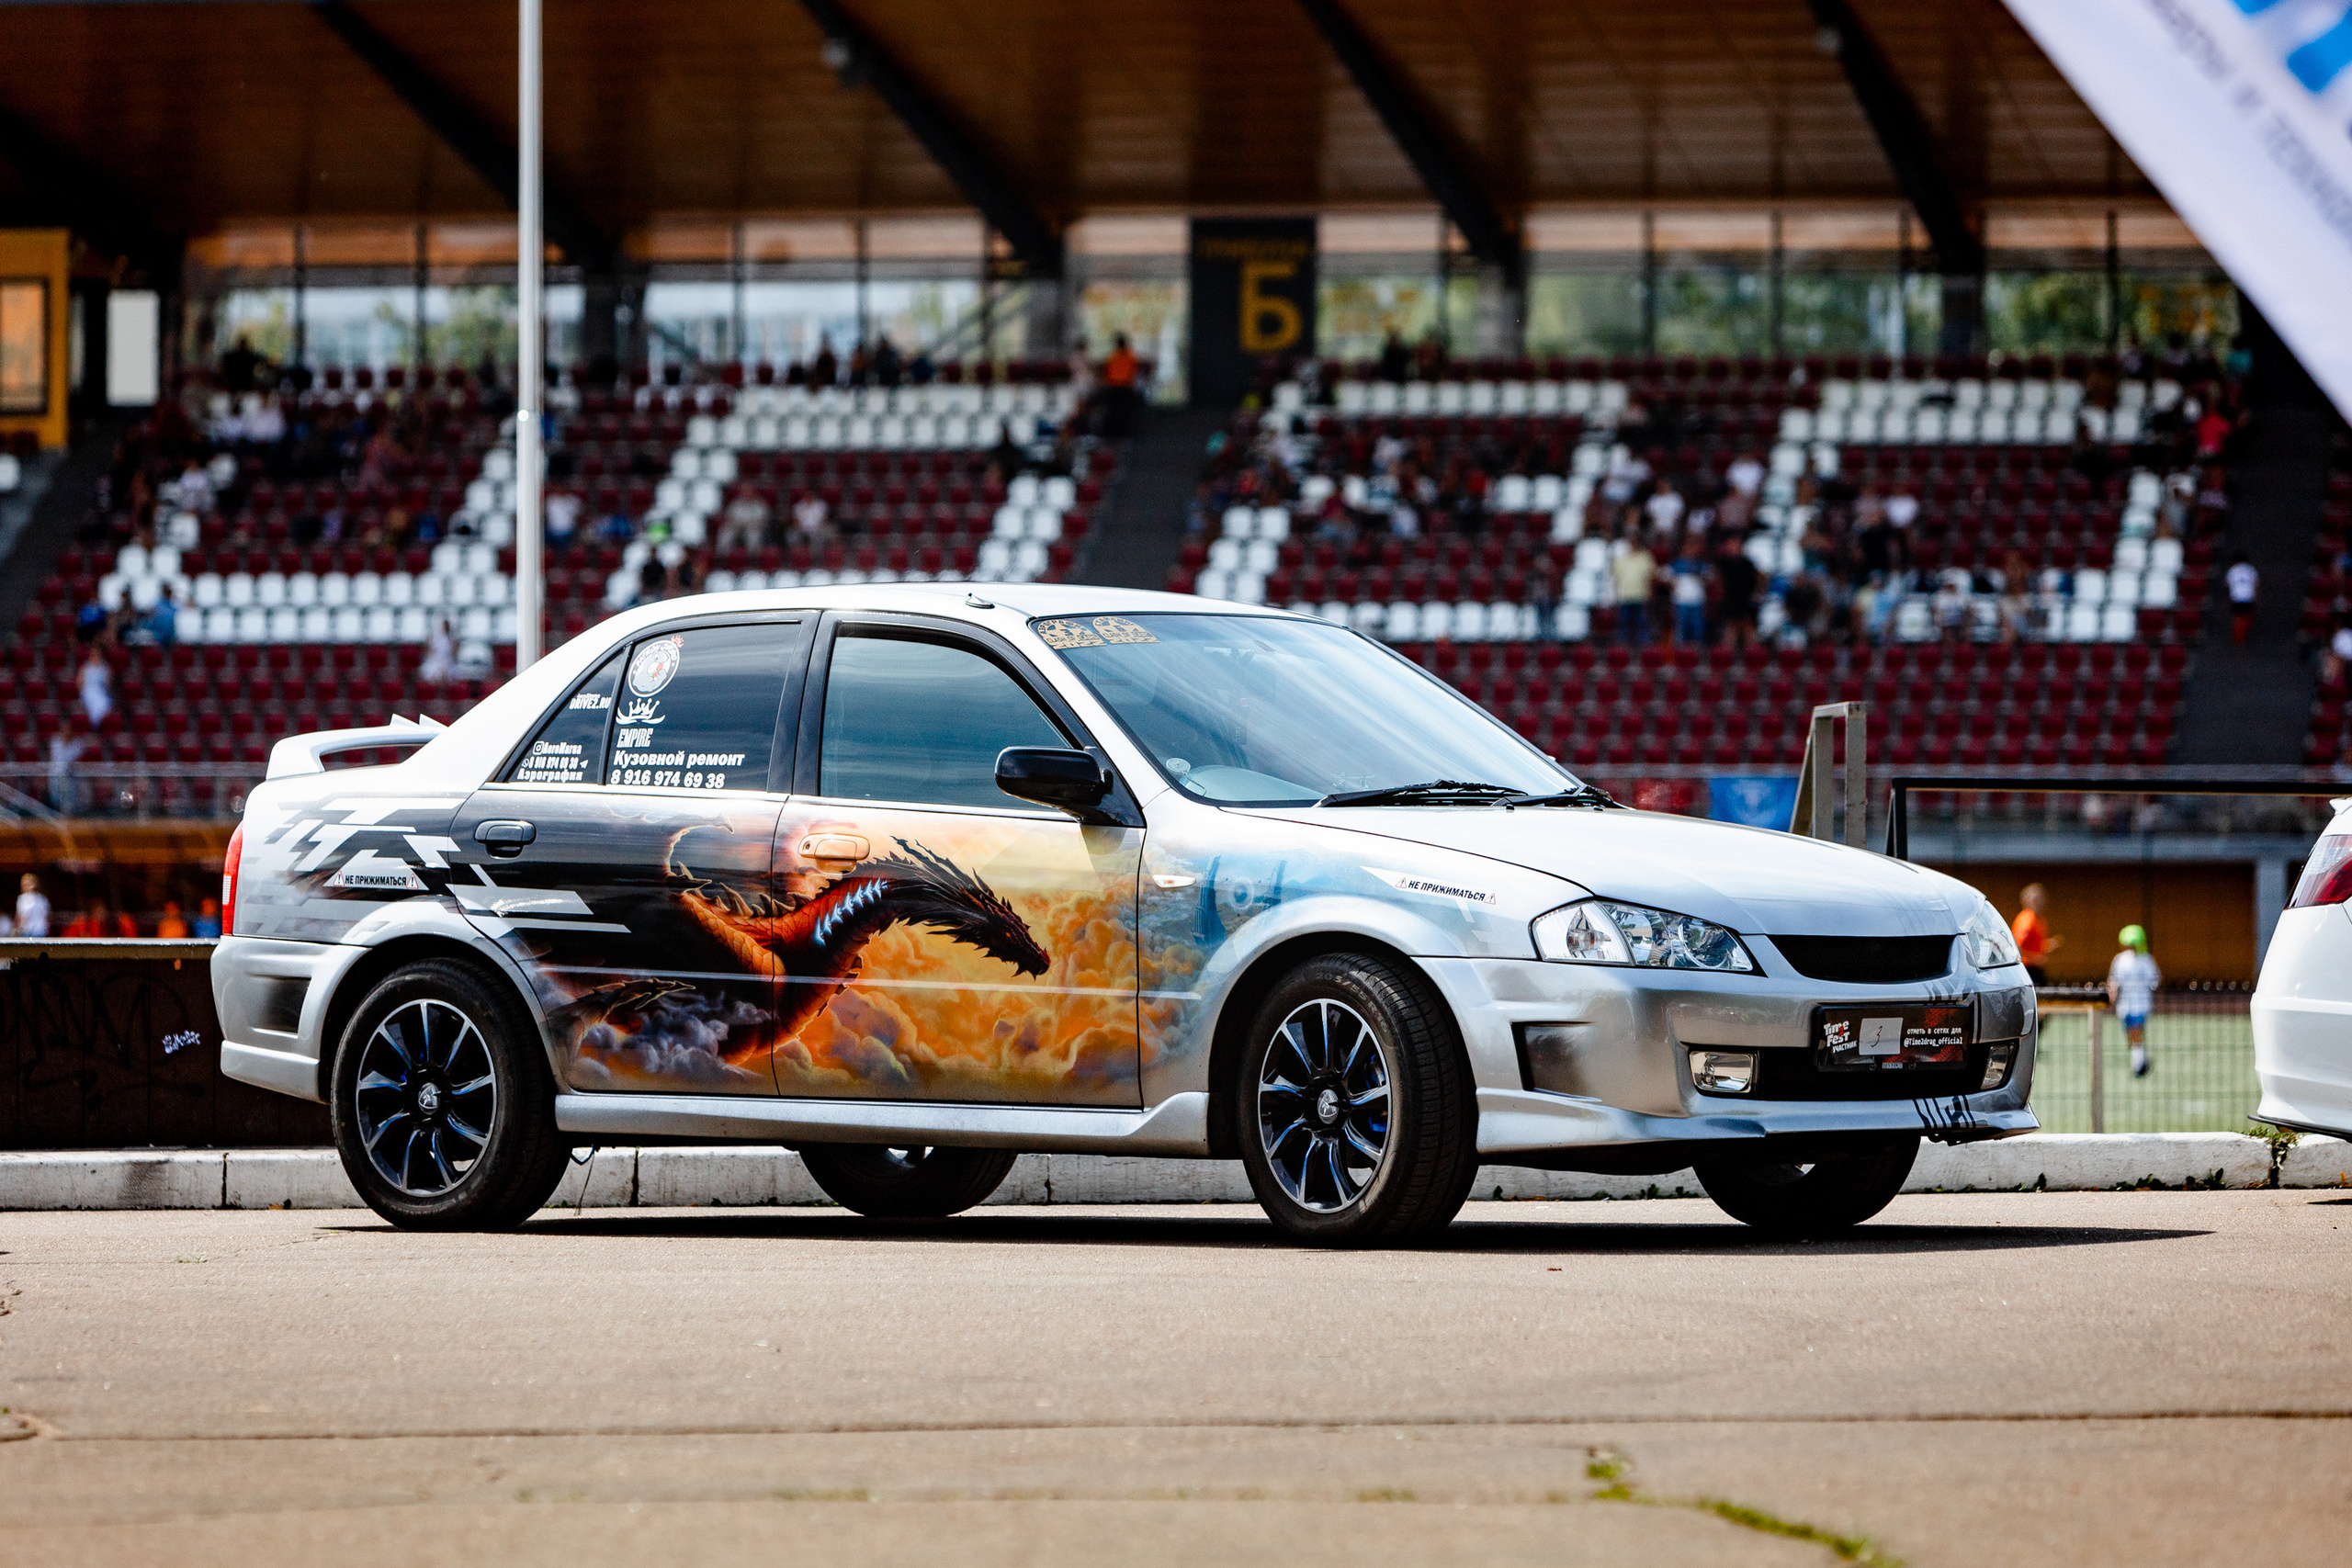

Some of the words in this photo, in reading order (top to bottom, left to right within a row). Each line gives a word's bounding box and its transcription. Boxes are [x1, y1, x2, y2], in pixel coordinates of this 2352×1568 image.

[1239, 262, 1303, 351] Б
[569, 696, 610, 710] DRIVE2.RU
[616, 728, 653, 748] EMPIRE
[613, 750, 684, 768] Кузовной
[686, 753, 745, 768] ремонт
[517, 768, 583, 783] Аэрография
[610, 769, 621, 785] 8
[624, 769, 651, 785] 916
[653, 770, 681, 786] 974
[684, 772, 703, 788] 69
[705, 773, 725, 789] 38
[345, 874, 355, 886] НЕ
[355, 875, 407, 886] ПРИЖИМАТЬСЯ
[1408, 880, 1420, 890] НЕ
[1420, 882, 1487, 901] ПРИЖИМАТЬСЯ
[1824, 1021, 1850, 1036] Time
[1826, 1032, 1850, 1048] Fest
[1832, 1040, 1858, 1054] УЧАСТНИК
